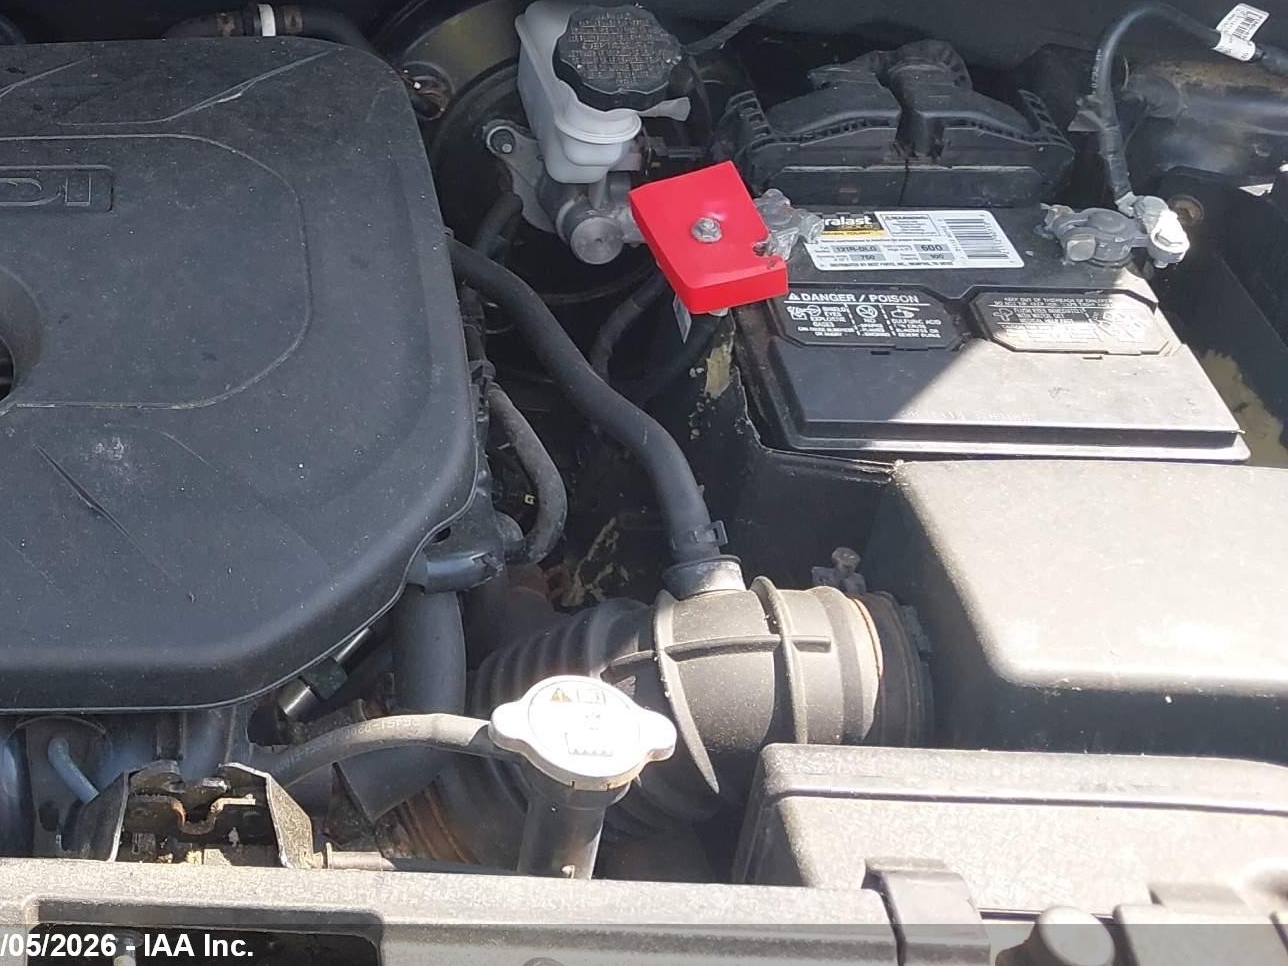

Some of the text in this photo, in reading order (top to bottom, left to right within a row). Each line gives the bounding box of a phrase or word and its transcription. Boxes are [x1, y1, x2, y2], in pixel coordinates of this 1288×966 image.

[824, 215, 873, 226] ralast
[920, 244, 944, 252] 600
[800, 292, 856, 302] DANGER
[868, 294, 920, 303] POISON
